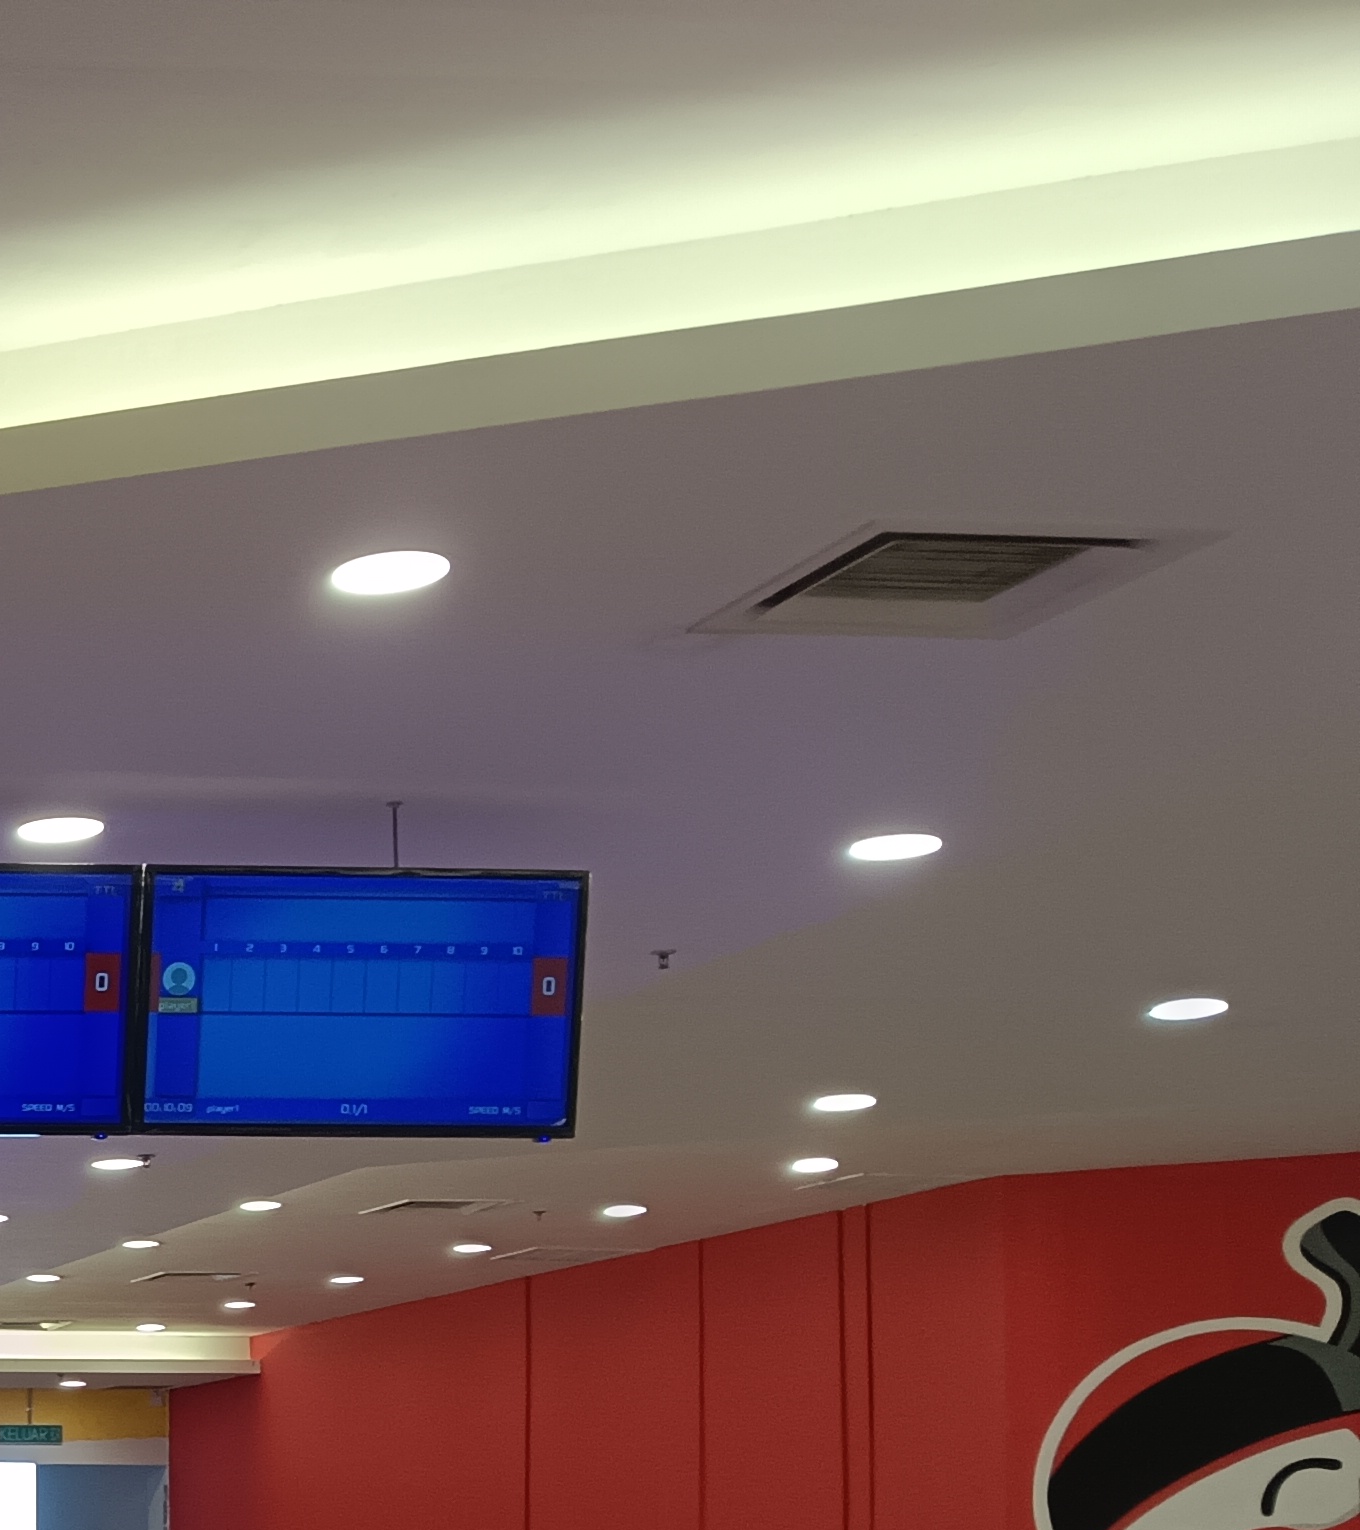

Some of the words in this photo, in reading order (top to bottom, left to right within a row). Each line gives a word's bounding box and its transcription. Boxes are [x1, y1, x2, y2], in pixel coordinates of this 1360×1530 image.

[31, 941, 39, 951] 9
[64, 941, 75, 951] 10
[245, 943, 254, 953] 2
[280, 943, 288, 953] 3
[312, 944, 321, 953] 4
[346, 944, 355, 954] 5
[380, 945, 389, 954] 6
[414, 945, 422, 954] 7
[480, 946, 489, 956] 9
[512, 946, 524, 956] 10
[95, 972, 109, 992] 0
[542, 976, 556, 996] 0
[21, 1103, 53, 1112] SPEED
[56, 1103, 75, 1113] M/S
[468, 1105, 499, 1115] SPEED
[0, 1427, 48, 1441] KELUAR
